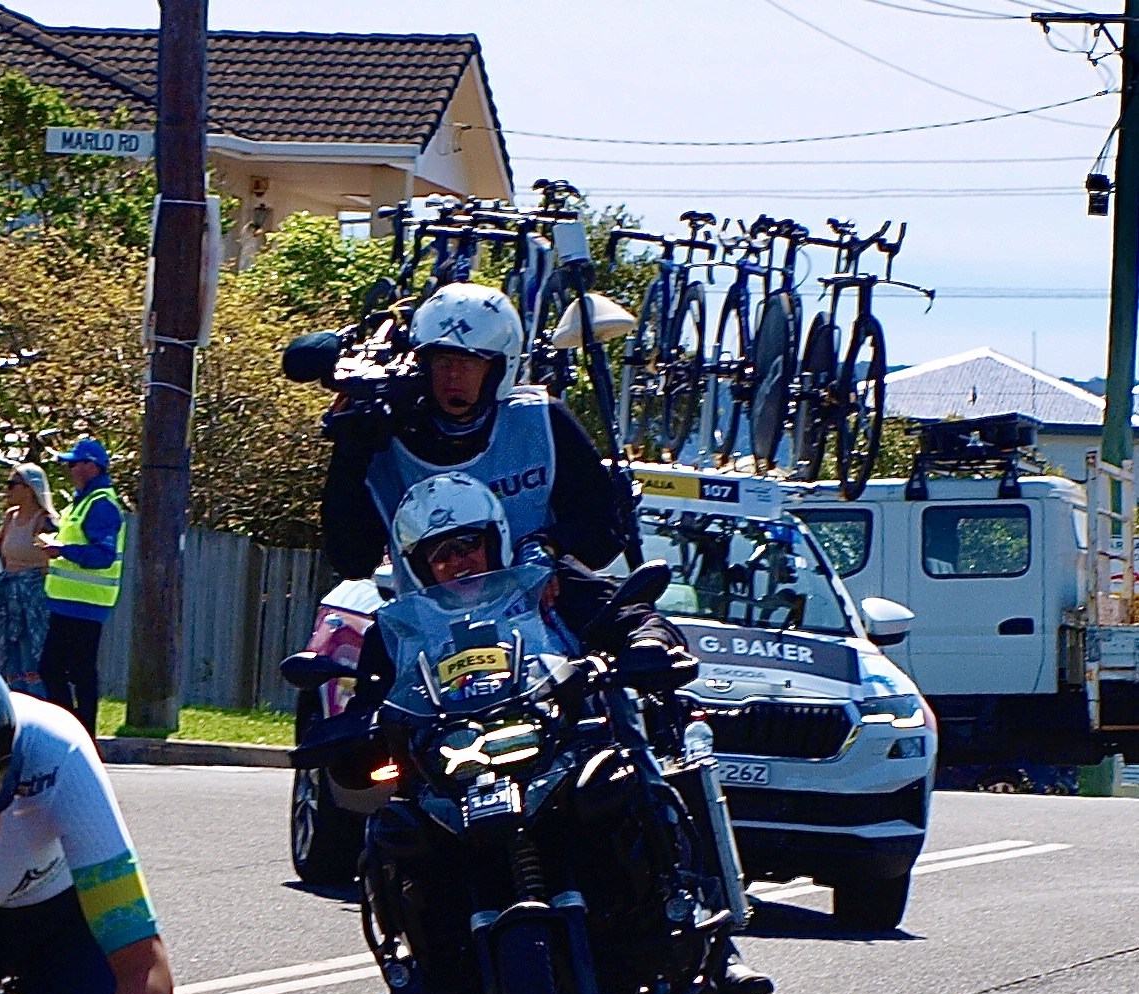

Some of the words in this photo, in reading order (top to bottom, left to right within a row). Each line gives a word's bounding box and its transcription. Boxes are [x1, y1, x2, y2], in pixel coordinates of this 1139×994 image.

[62, 131, 114, 151] MARLO
[118, 133, 140, 153] RD
[500, 465, 547, 497] UCI
[702, 484, 733, 499] 107
[699, 635, 727, 653] G.
[731, 638, 814, 664] BAKER
[447, 654, 497, 674] PRESS
